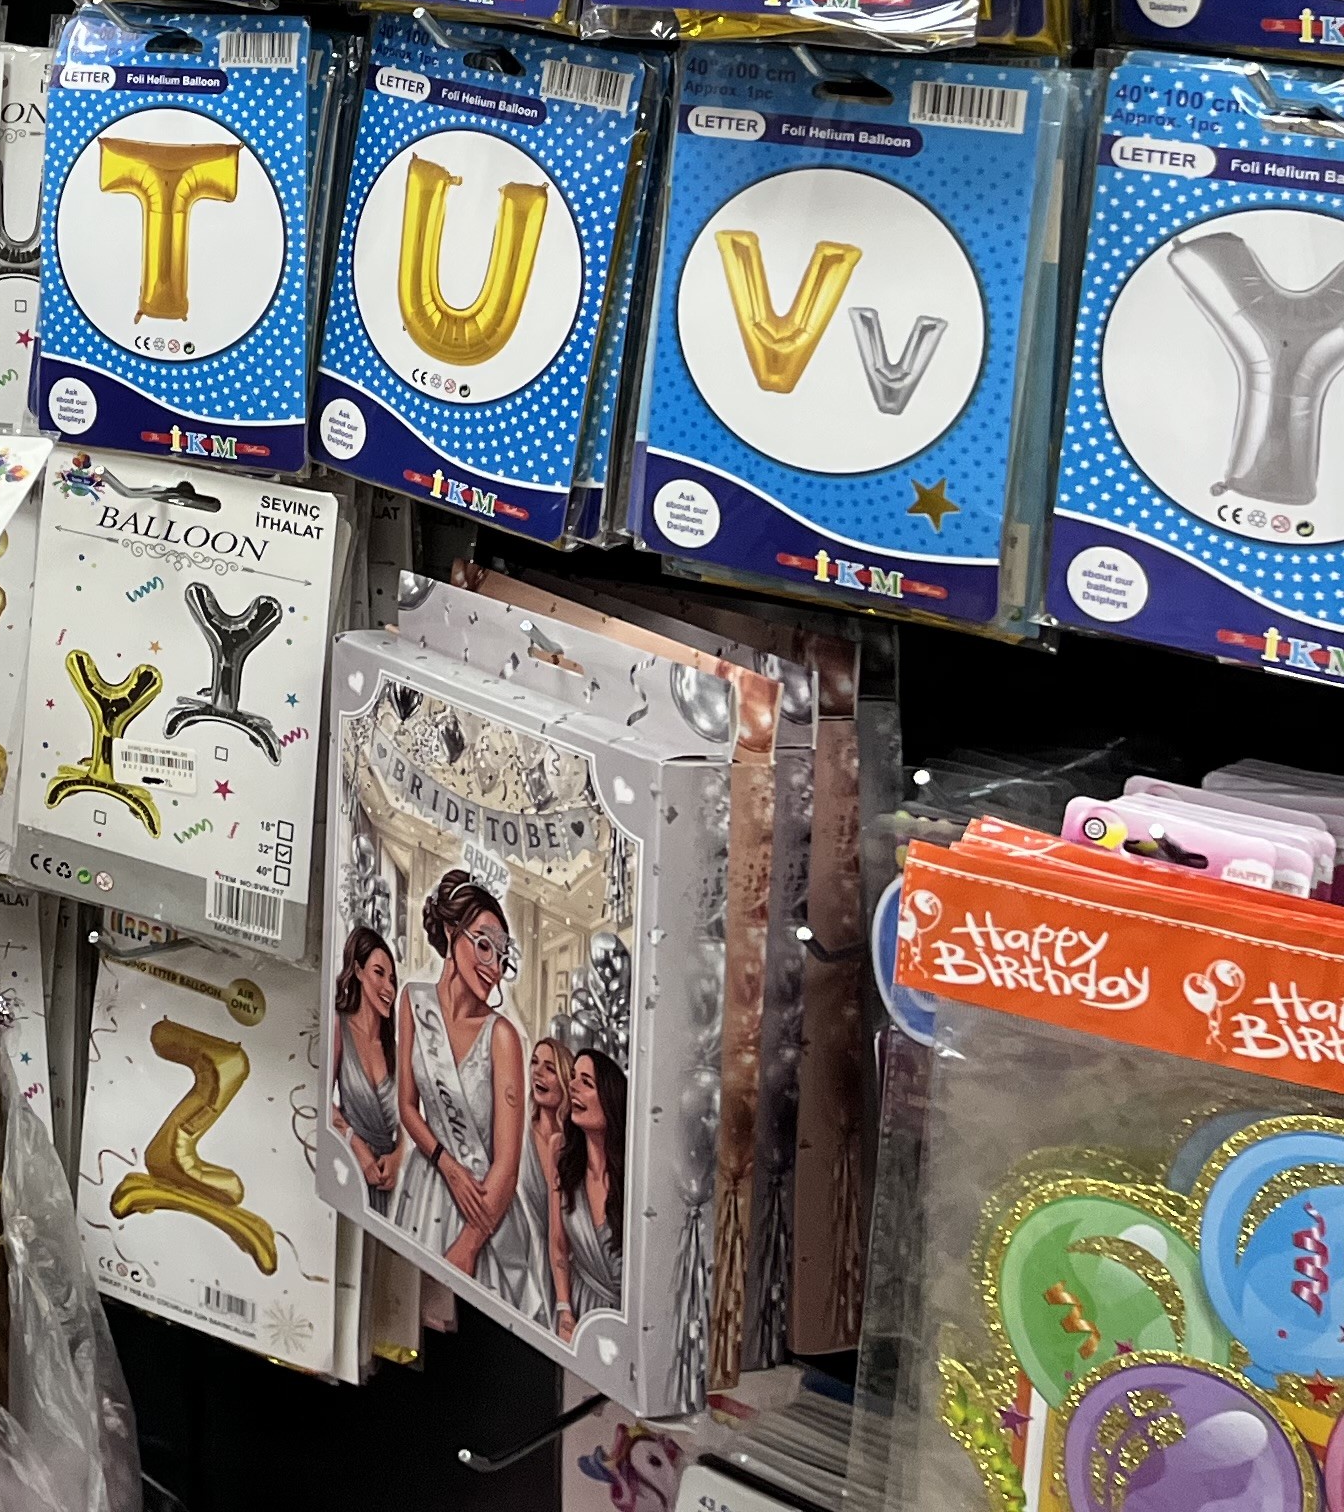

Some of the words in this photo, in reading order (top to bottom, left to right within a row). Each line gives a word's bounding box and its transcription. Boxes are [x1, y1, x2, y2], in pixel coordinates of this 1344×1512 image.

[64, 70, 110, 84] LETTER
[148, 74, 181, 86] Helium
[182, 76, 221, 88] Balloon
[379, 72, 426, 96] LETTER
[461, 91, 497, 111] Helium
[498, 98, 540, 118] Balloon
[1162, 87, 1204, 111] 100
[694, 113, 760, 133] LETTER
[1111, 107, 1184, 130] Approx.
[1188, 115, 1220, 135] 1pc
[809, 126, 855, 144] Helium
[858, 131, 913, 150] Balloon
[1118, 145, 1197, 170] LETTER
[1263, 160, 1321, 182] Helium
[98, 136, 244, 324] T
[397, 151, 550, 366] U
[714, 229, 863, 394] V
[1167, 231, 1344, 506] Y
[96, 504, 270, 563] BALLOON
[1082, 568, 1113, 585] about
[1114, 576, 1134, 588] our
[1097, 559, 1119, 574] Ask
[1086, 582, 1126, 599] balloon
[393, 757, 476, 837] BRIDE
[485, 815, 520, 848] TO
[527, 818, 558, 851] BE
[1225, 864, 1270, 884] HAPPY
[951, 913, 1109, 969] Happy
[230, 998, 260, 1015] ONLY
[236, 988, 255, 1001] AIR
[145, 1019, 250, 1208] Z
